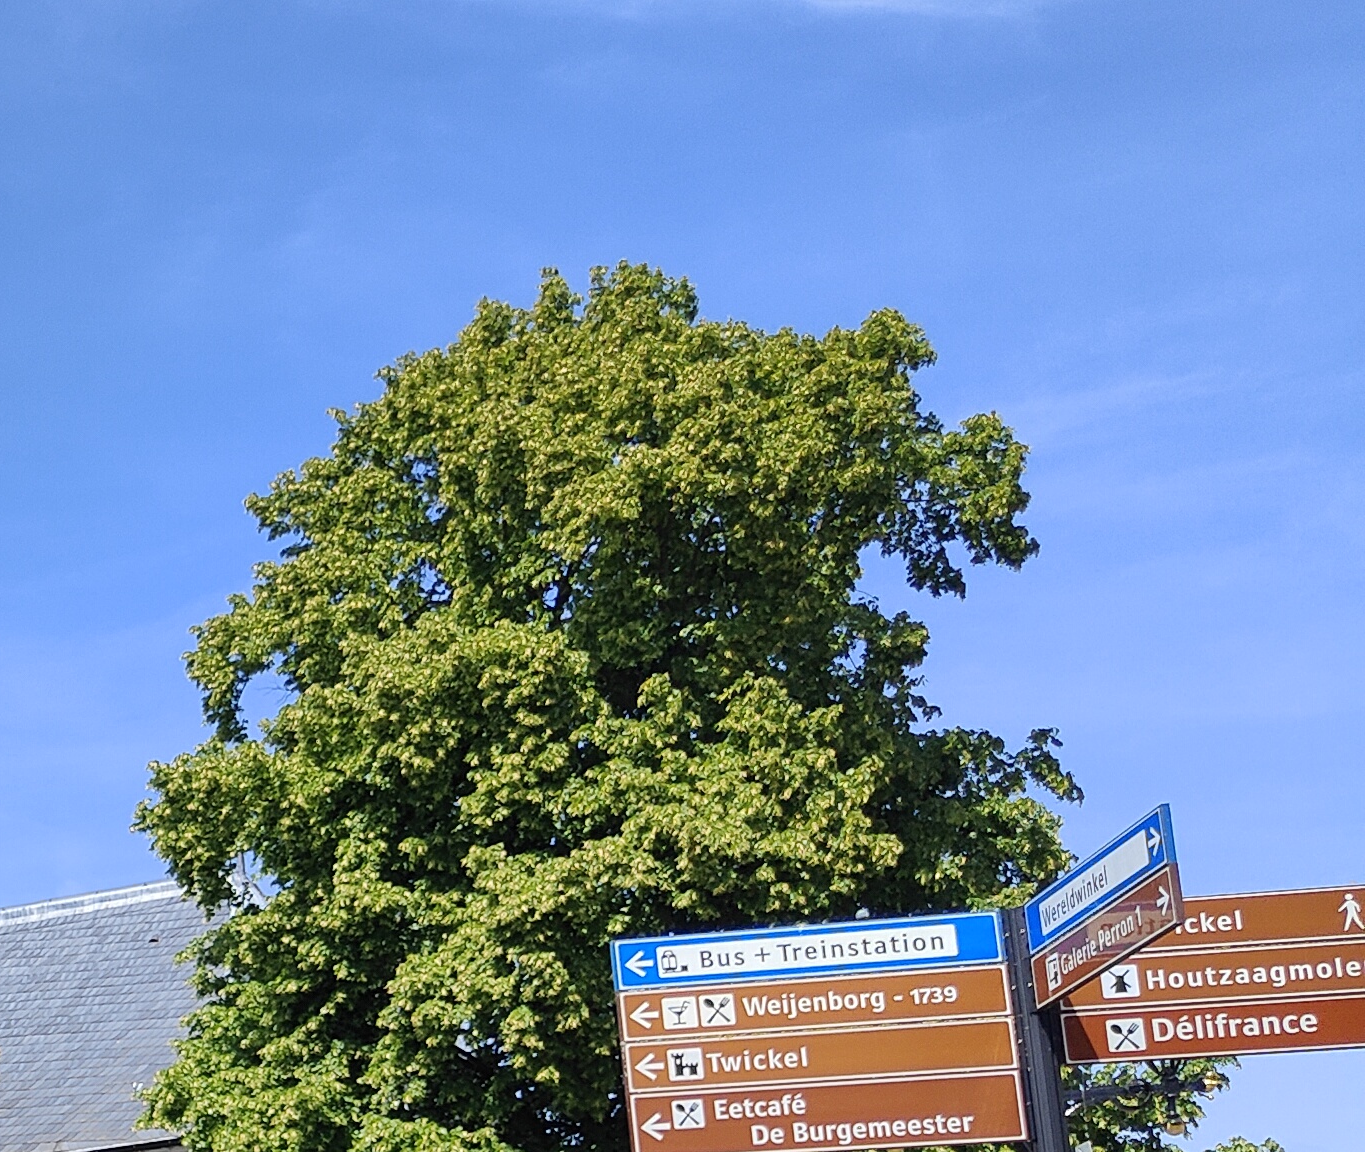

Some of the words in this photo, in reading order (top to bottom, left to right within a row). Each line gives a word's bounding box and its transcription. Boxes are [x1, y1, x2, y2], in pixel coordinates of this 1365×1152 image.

[1041, 865, 1109, 928] Wereldwinkel
[699, 950, 746, 969] Bus
[754, 947, 771, 963] +
[776, 932, 945, 963] Treinstation
[1060, 935, 1097, 975] Galerie
[1097, 913, 1135, 951] Perron
[1135, 904, 1143, 927] 1
[1145, 956, 1365, 990] Houtzaagmole
[741, 990, 886, 1020] Weijenborg
[892, 994, 904, 1002] -
[909, 985, 959, 1006] 1739
[1151, 1013, 1319, 1043] Délifrance
[706, 1047, 809, 1073] Twickel
[713, 1093, 807, 1121] Eetcafé
[750, 1123, 785, 1146] De
[792, 1113, 975, 1145] Burgemeester
